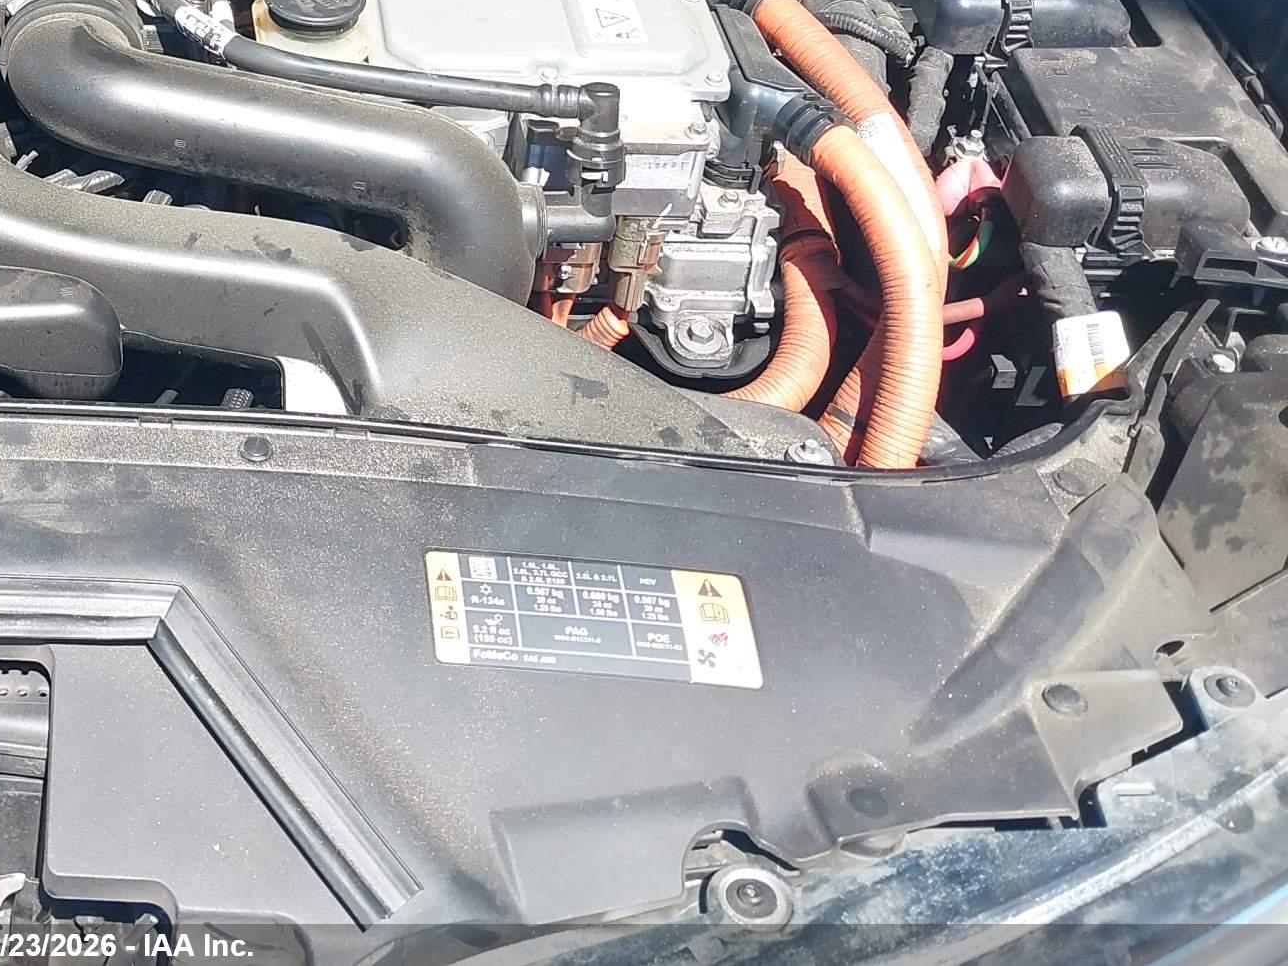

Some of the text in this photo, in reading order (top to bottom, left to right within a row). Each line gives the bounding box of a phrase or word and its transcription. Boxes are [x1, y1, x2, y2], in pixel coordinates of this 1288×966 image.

[551, 588, 564, 599] kg
[607, 592, 619, 603] kg
[470, 594, 506, 606] R-134a
[658, 596, 671, 608] kg
[472, 624, 511, 636] 5.2 fl oz
[564, 626, 589, 637] PAG
[497, 636, 513, 645] cc)
[647, 632, 671, 643] POE
[472, 648, 519, 662] FoMoCo
